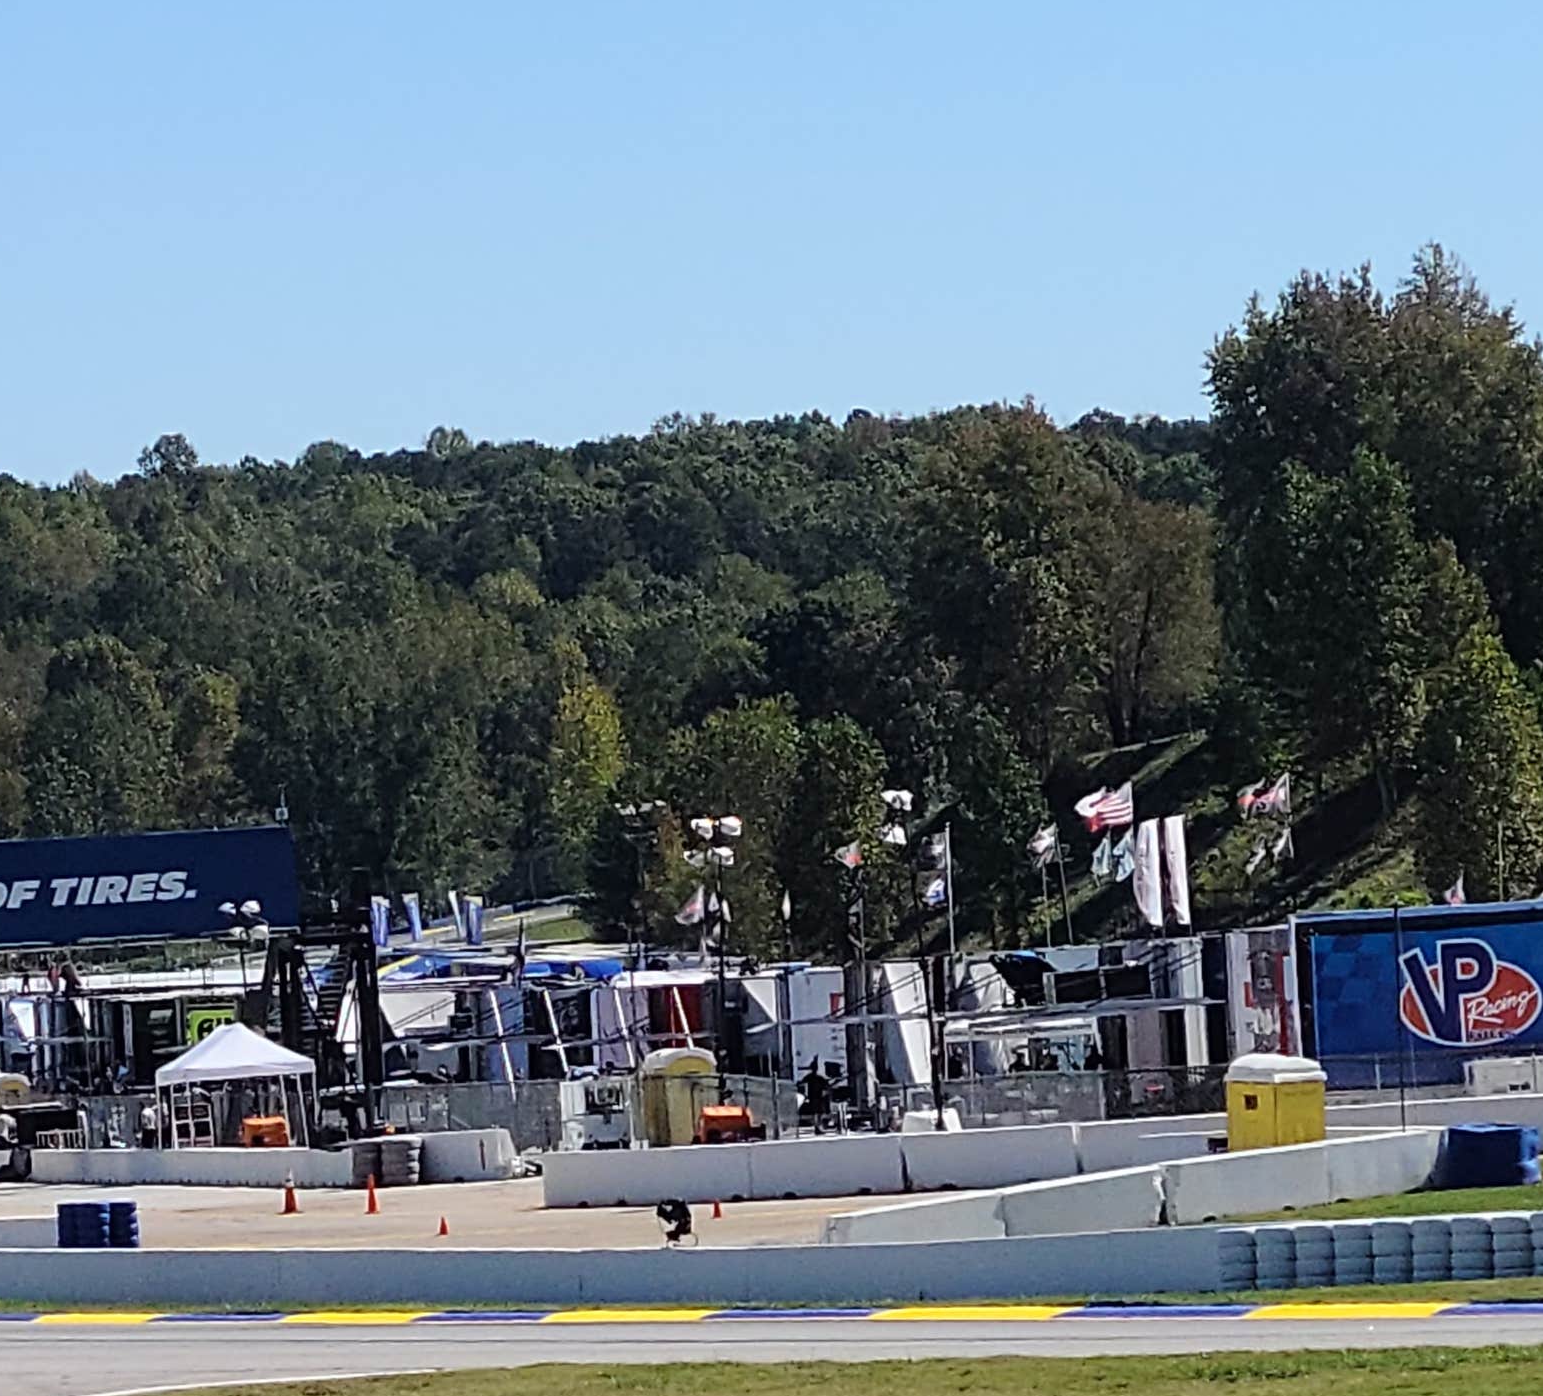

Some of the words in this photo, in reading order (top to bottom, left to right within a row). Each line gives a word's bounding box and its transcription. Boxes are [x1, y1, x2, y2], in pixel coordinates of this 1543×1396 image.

[49, 871, 197, 906] TIRES.
[1399, 937, 1497, 1045] VP
[1467, 990, 1538, 1031] Racing
